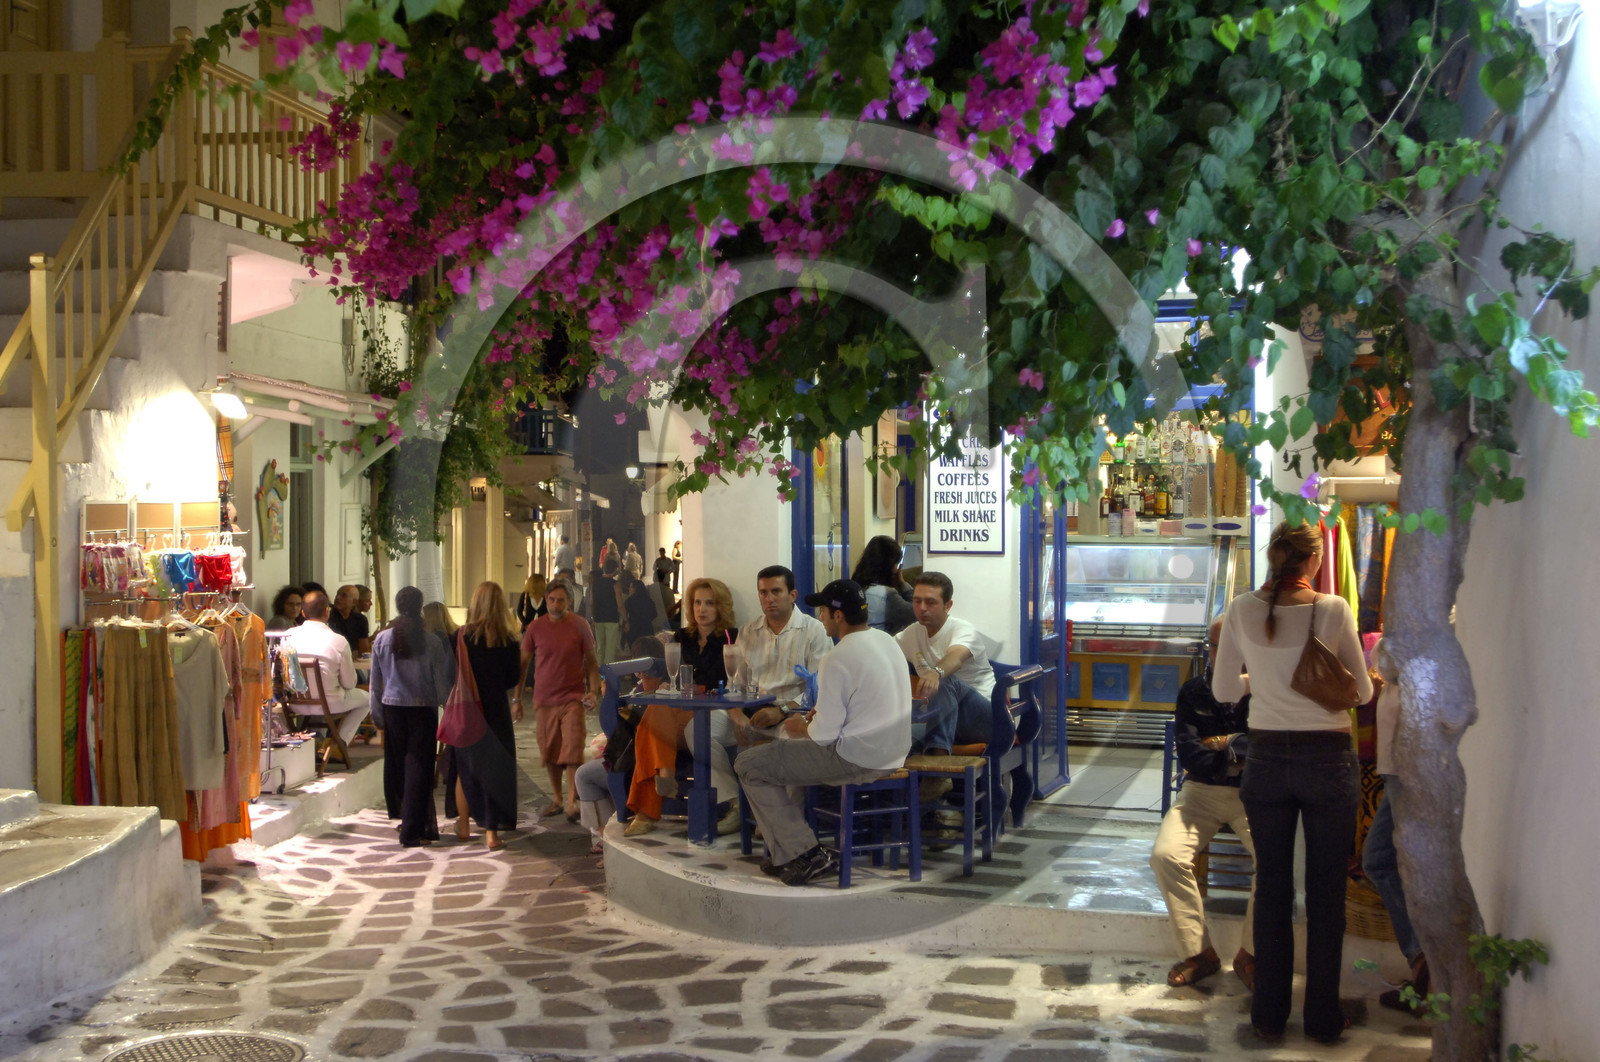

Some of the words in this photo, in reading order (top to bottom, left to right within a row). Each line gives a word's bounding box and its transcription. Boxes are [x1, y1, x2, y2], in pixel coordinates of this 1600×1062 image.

[937, 473, 989, 486] COFFEES
[934, 491, 963, 504] FRESH
[965, 491, 997, 504] JUICES
[934, 510, 960, 523] MILK
[962, 510, 997, 523] SHAKE
[940, 529, 990, 542] DRINKS
